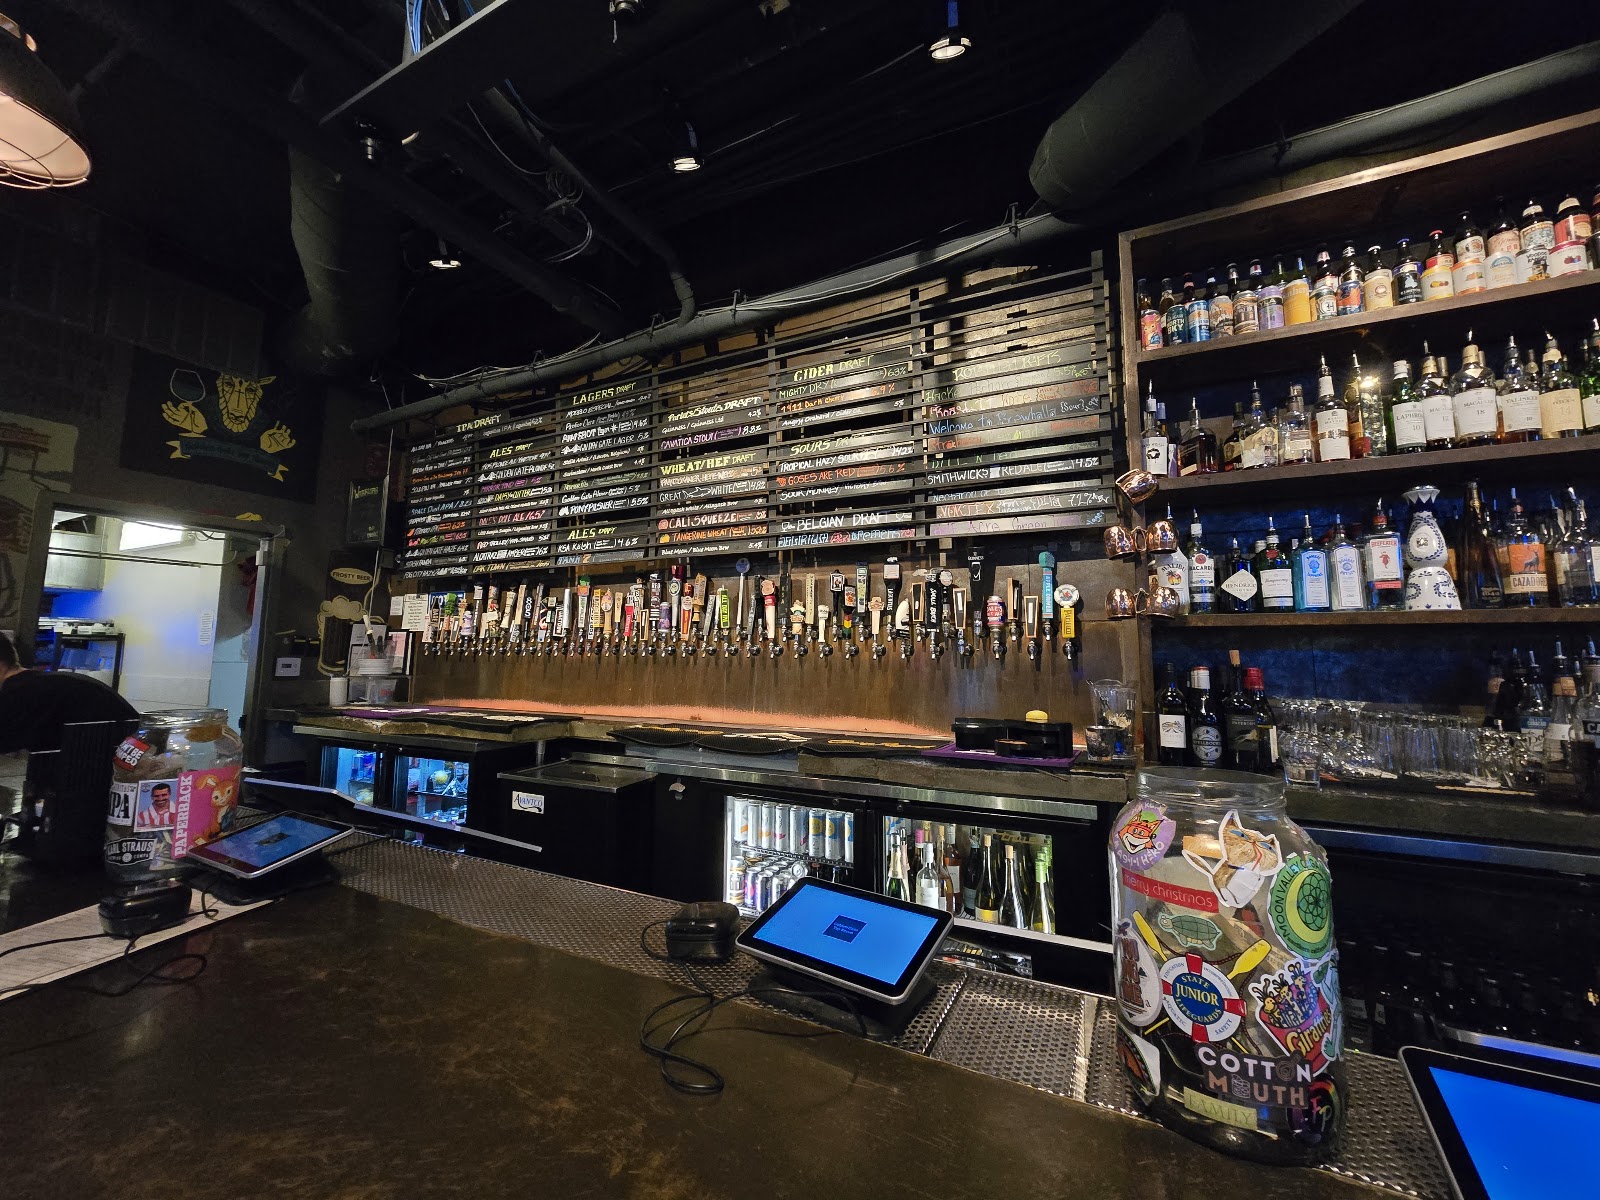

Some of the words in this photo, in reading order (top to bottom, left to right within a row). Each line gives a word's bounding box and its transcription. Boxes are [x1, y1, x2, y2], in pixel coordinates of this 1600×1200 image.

[793, 363, 834, 381] CIDER
[839, 354, 874, 371] DRAFT
[572, 388, 614, 405] LAGERS
[615, 382, 636, 394] DRAFT
[779, 386, 807, 398] MIGHTY
[809, 381, 829, 393] DRY
[724, 397, 761, 410] DRAFT
[474, 414, 501, 428] DRAFT
[489, 446, 513, 458] ALES
[790, 439, 831, 455] SOURS
[732, 453, 756, 464] DRAFT
[779, 460, 814, 473] TROPICAL
[816, 455, 838, 466] HAZY
[788, 473, 817, 485] GOSES
[819, 470, 832, 480] ARE
[835, 467, 856, 479] RED
[660, 491, 681, 502] GREAT
[710, 484, 734, 496] WHITE
[668, 518, 690, 529] CALI
[691, 513, 737, 526] SQUEEZE
[797, 515, 844, 531] BELGIAN
[567, 527, 596, 540] ALES
[672, 530, 706, 542] TANGERINE
[707, 528, 729, 537] WHEAT
[557, 544, 570, 553] KSA
[332, 571, 355, 579] FROSTY
[174, 774, 193, 857] PAPERBACK
[1277, 861, 1299, 893] VALLEY
[1124, 875, 1150, 895] merry
[1153, 884, 1213, 908] christmas
[1275, 896, 1290, 938] MOON
[1181, 975, 1210, 989] STATE
[1176, 983, 1220, 1006] JUNIOR
[1163, 996, 1187, 1027] AQUATIC
[1176, 998, 1222, 1023] LIFEGUARDS
[1214, 1018, 1233, 1036] SAFETY
